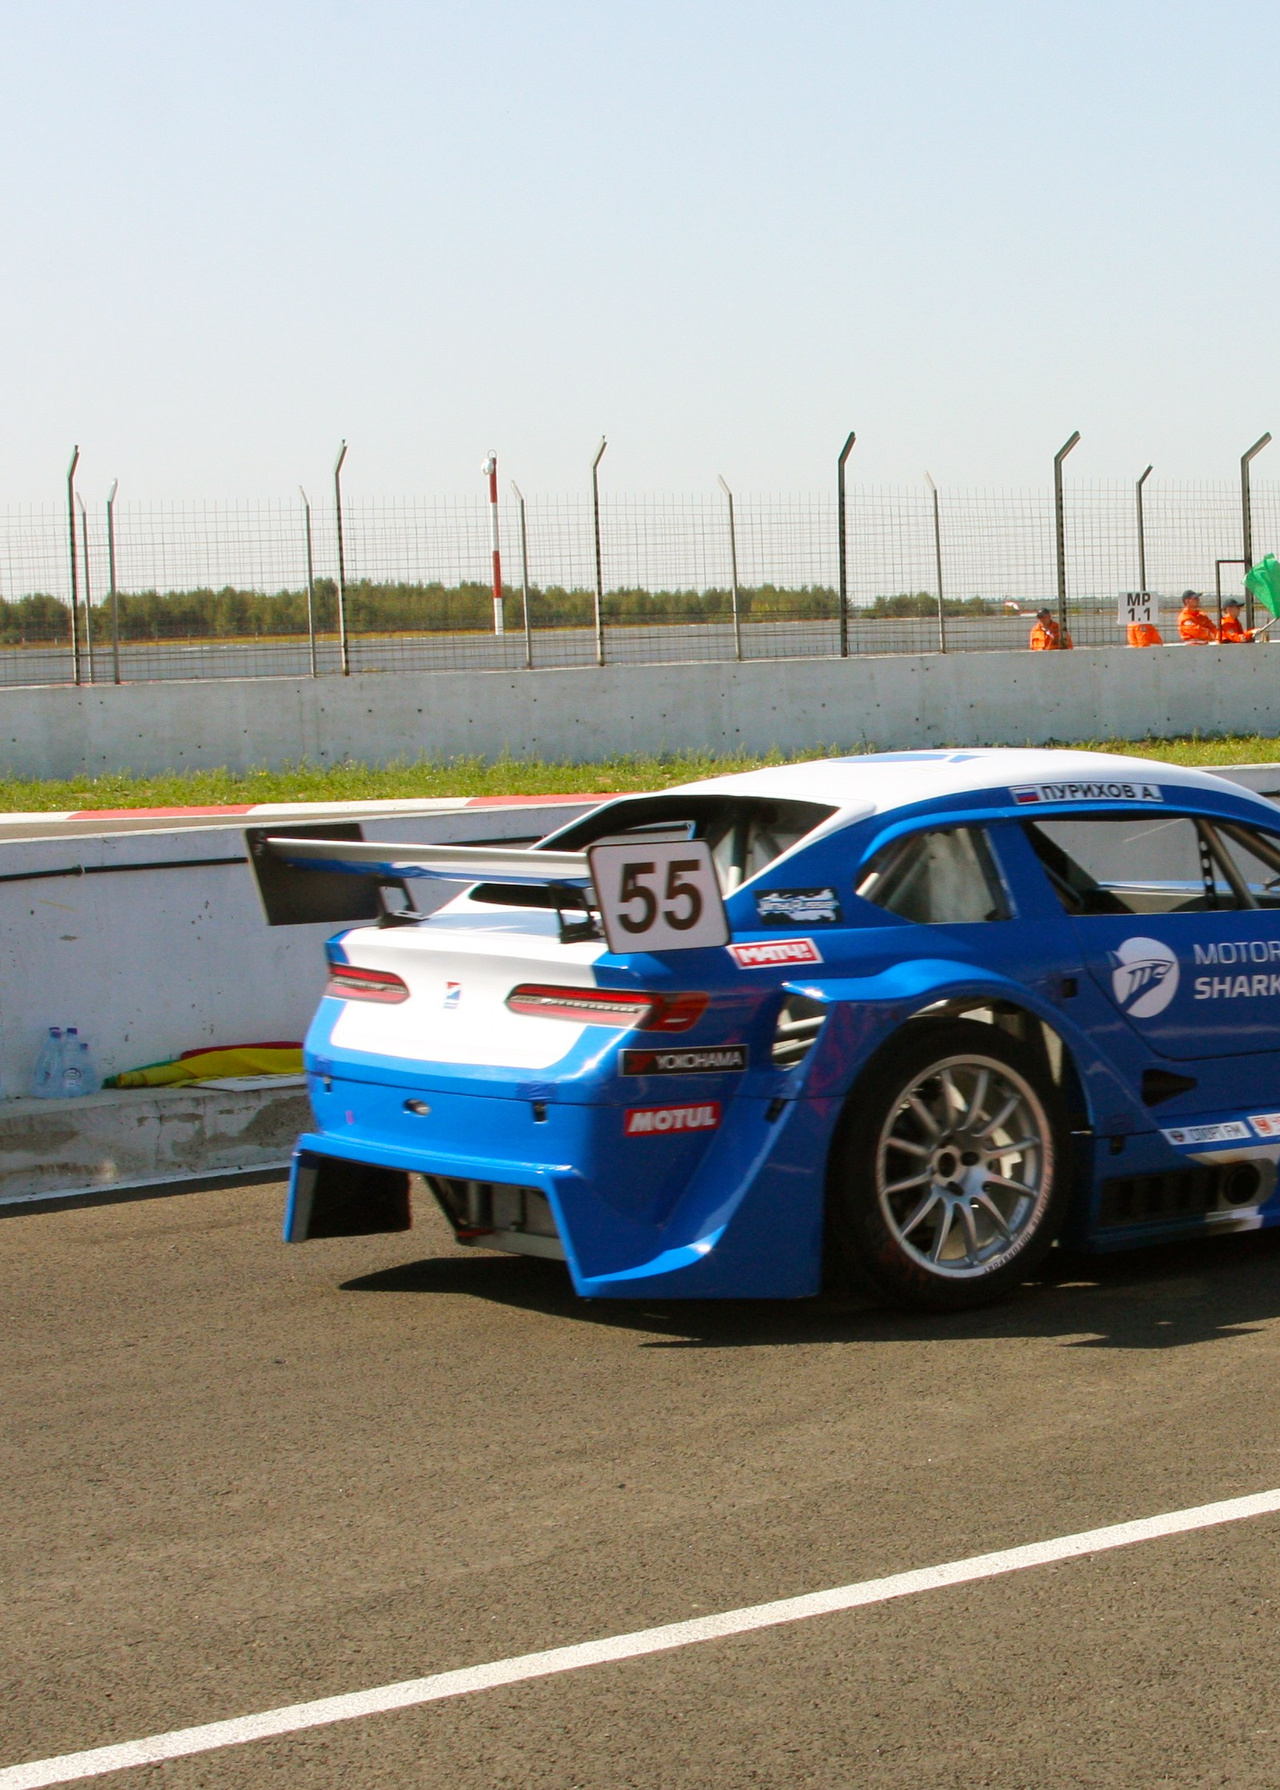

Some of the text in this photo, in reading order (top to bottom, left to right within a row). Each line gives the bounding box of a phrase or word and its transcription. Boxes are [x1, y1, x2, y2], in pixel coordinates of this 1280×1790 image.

[1128, 607, 1151, 621] 1.1
[1040, 783, 1135, 800] ПУРИХОВ
[617, 859, 702, 934] 55
[655, 1051, 743, 1070] YOKOHAMA
[628, 1106, 716, 1132] MOTUL
